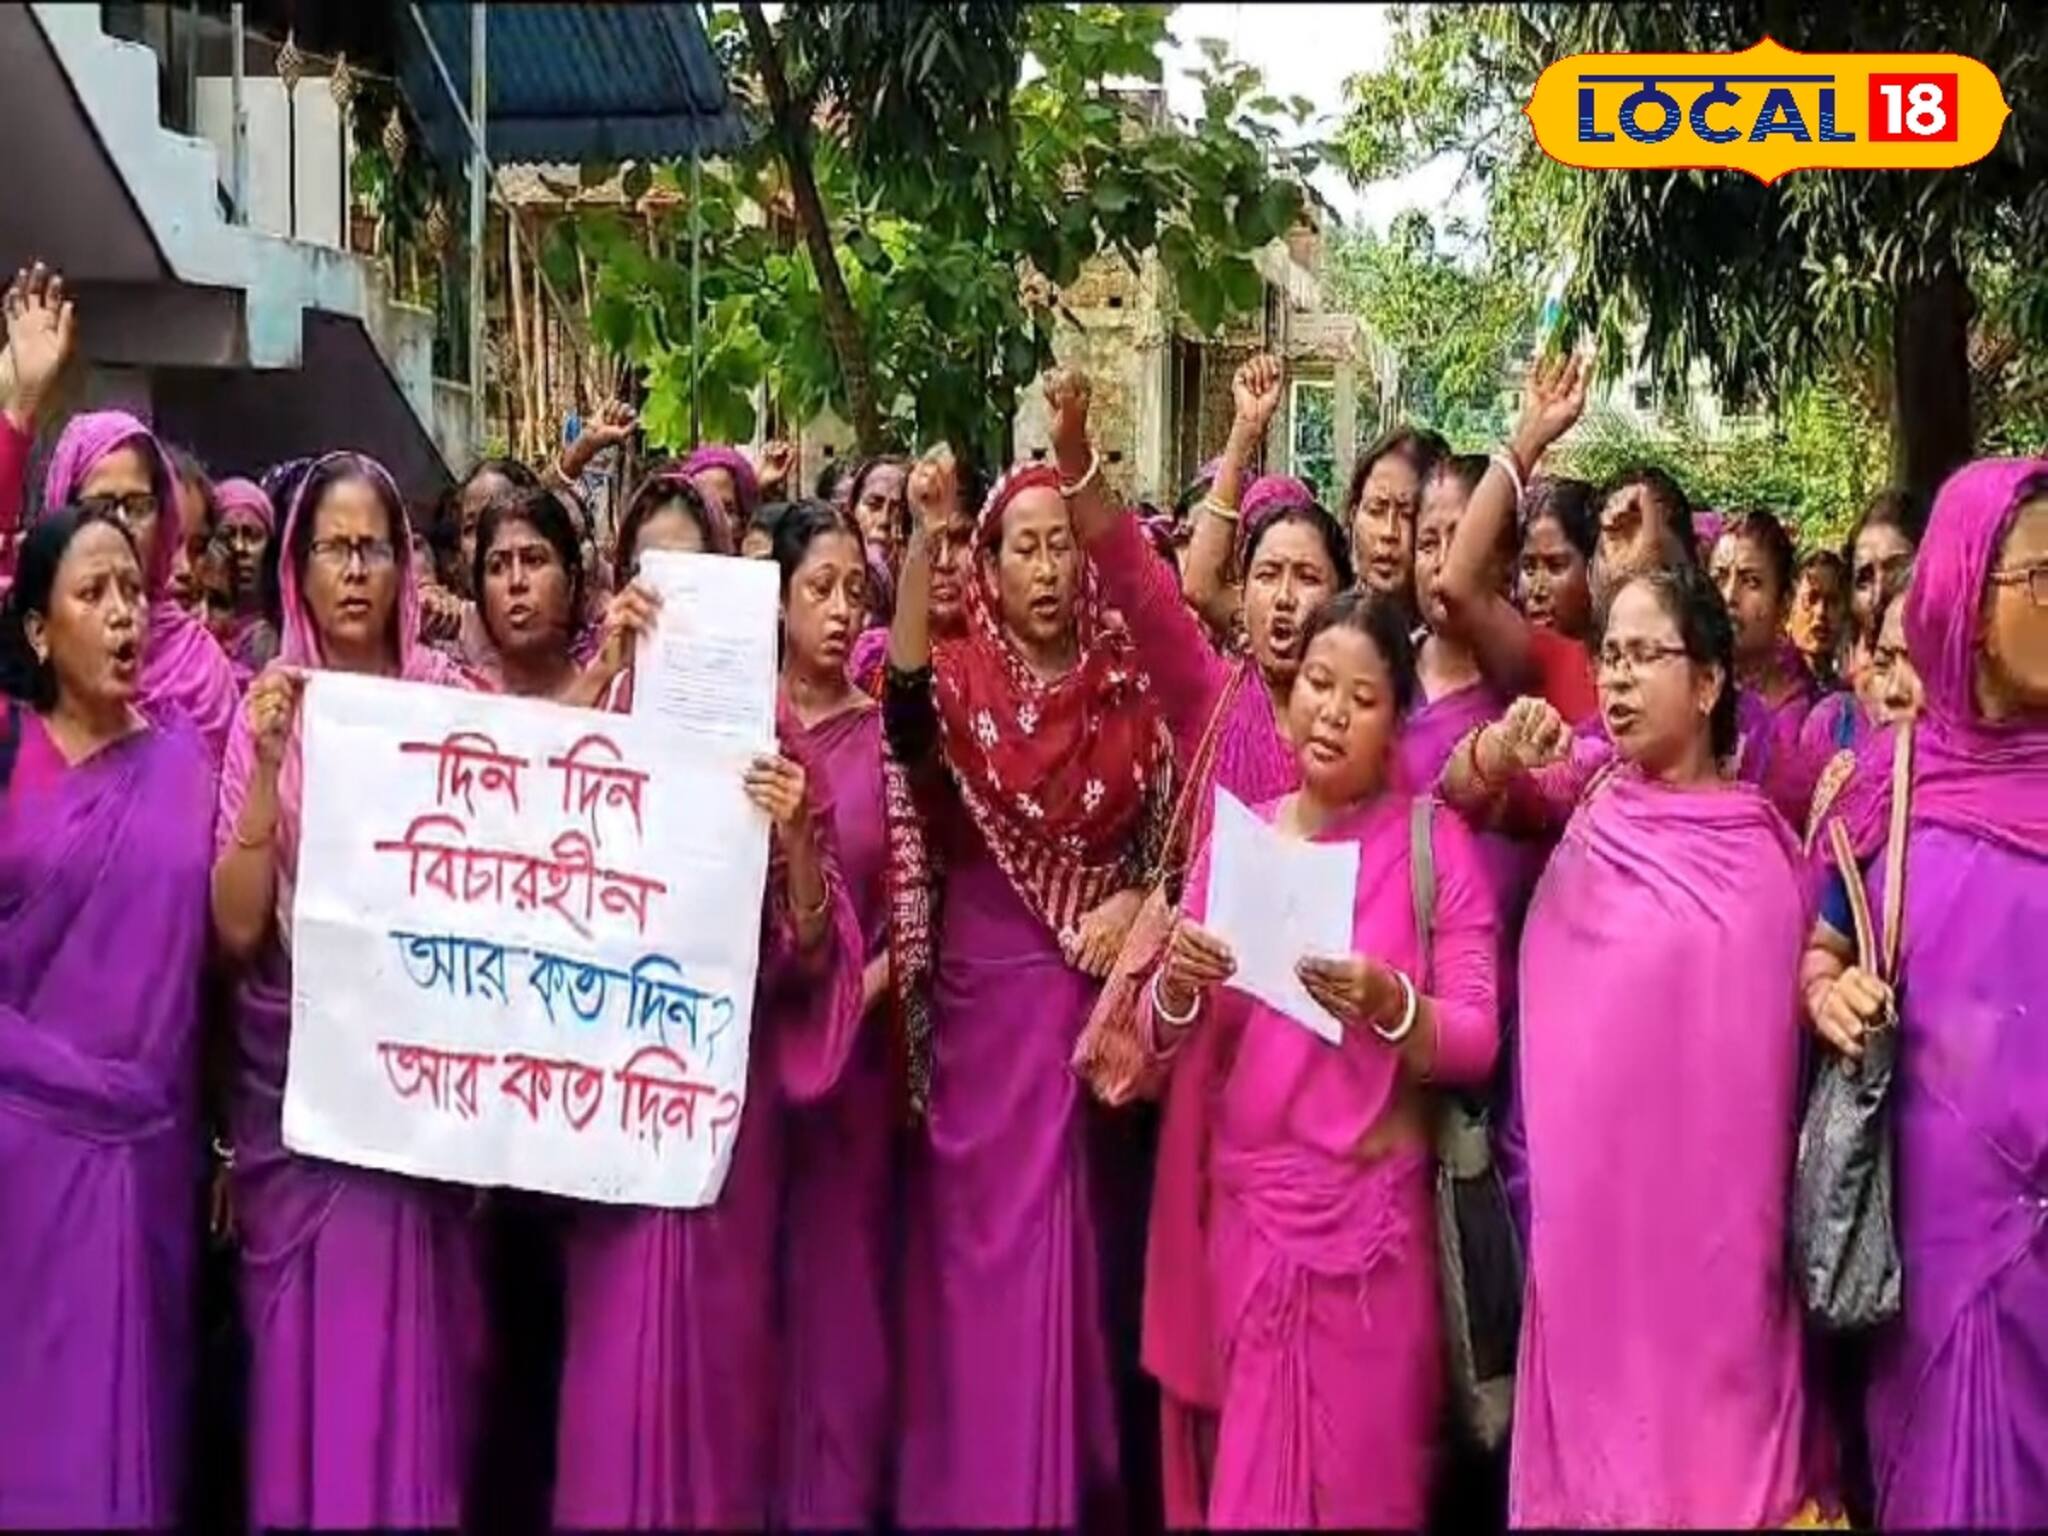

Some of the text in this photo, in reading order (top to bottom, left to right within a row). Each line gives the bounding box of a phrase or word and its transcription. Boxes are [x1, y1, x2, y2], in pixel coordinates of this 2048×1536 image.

[399, 732, 650, 849] দিন দিন
[374, 812, 668, 941] বিচারহীন
[388, 930, 530, 1006] আর
[528, 950, 630, 1026] কত
[377, 1042, 497, 1121] আর
[499, 1052, 604, 1132] কত
